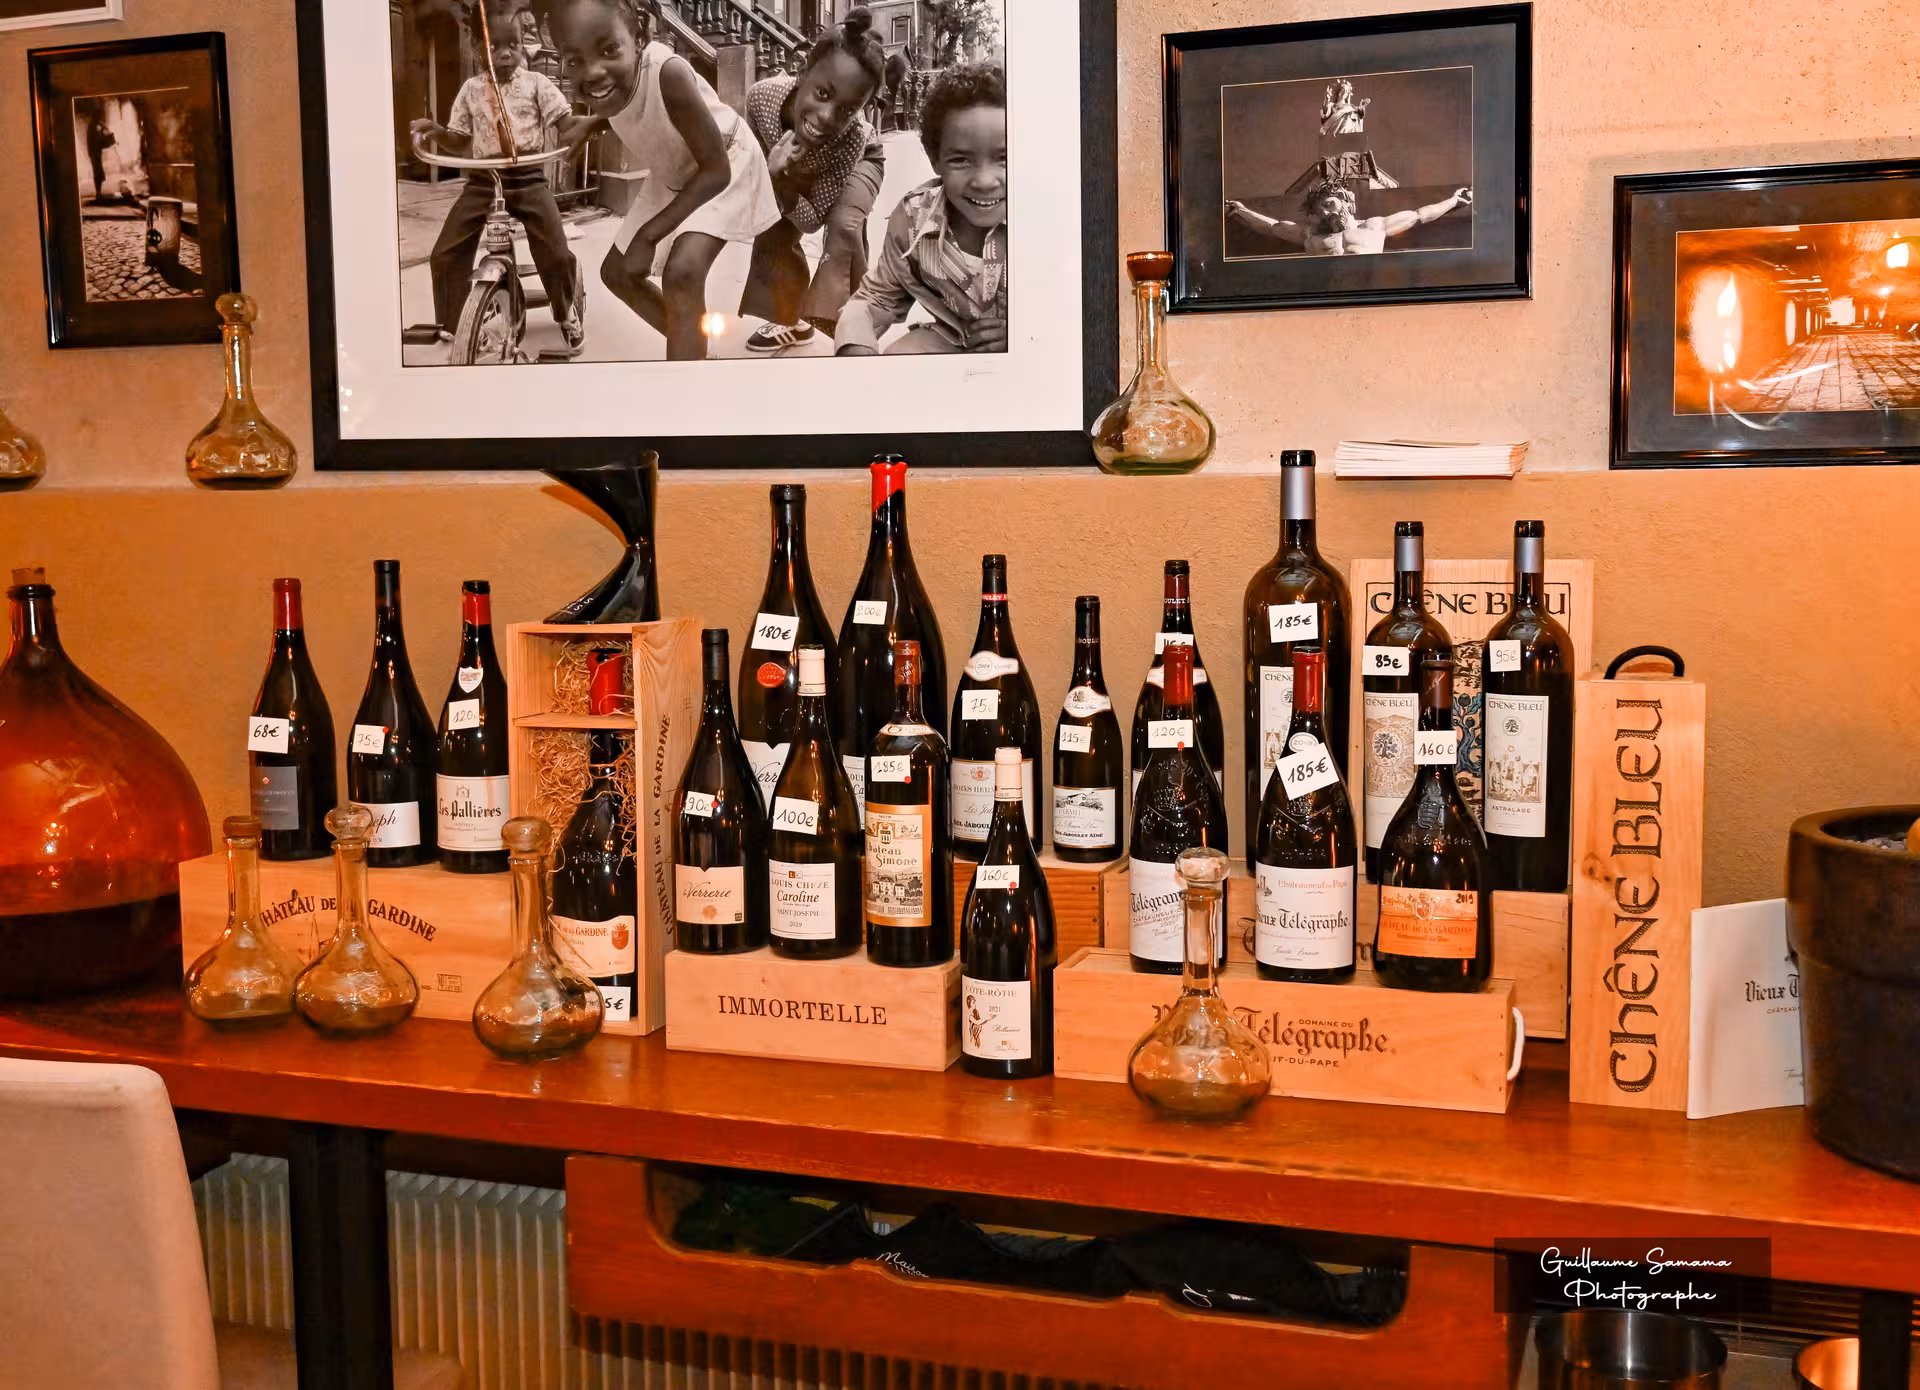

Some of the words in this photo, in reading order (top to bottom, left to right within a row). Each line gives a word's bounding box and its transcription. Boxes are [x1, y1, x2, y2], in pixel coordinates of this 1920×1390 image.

[1370, 589, 1477, 615] CÊNE
[1485, 592, 1566, 615] BU
[856, 604, 882, 617] 200€
[1274, 615, 1313, 630] 185€
[759, 625, 791, 640] 180€
[1375, 654, 1402, 669] 85€
[1496, 650, 1518, 665] 95€
[1389, 699, 1413, 708] BLEU
[1518, 702, 1543, 711] BLEU
[253, 724, 280, 738] 68€
[1152, 726, 1185, 738] 120€
[357, 733, 381, 748] 75€
[653, 714, 671, 799] GARDINE
[873, 761, 904, 773] 185€
[1288, 757, 1329, 783] 185€
[1610, 699, 1663, 859] BLEU
[438, 797, 449, 815] Les
[450, 800, 502, 820] Pallières
[687, 796, 711, 811] 90€
[1492, 806, 1531, 814] ASTRALABE
[654, 808, 661, 827] LA
[776, 809, 814, 827] 100€
[876, 853, 917, 867] Simone
[979, 869, 1009, 881] 160€
[771, 878, 793, 888] LOUIS
[777, 889, 820, 903] Caroline
[260, 896, 315, 927] HÂTEAU
[321, 898, 337, 911] DE
[368, 899, 437, 942] GARDINE
[776, 908, 819, 917] SAINT-JOSEPH
[1278, 908, 1350, 934] Télégraphe
[576, 927, 609, 937] GARDINE
[965, 984, 1017, 998] CÔTE-RÔTIE
[1602, 876, 1660, 1093] CHÊNE
[1745, 980, 1786, 1002] Vieux
[717, 995, 887, 1026] IMMORTELLE
[988, 1005, 1001, 1013] 2021
[1298, 1018, 1339, 1027] DOMAINE
[1233, 1006, 1390, 1059] Télégraphe
